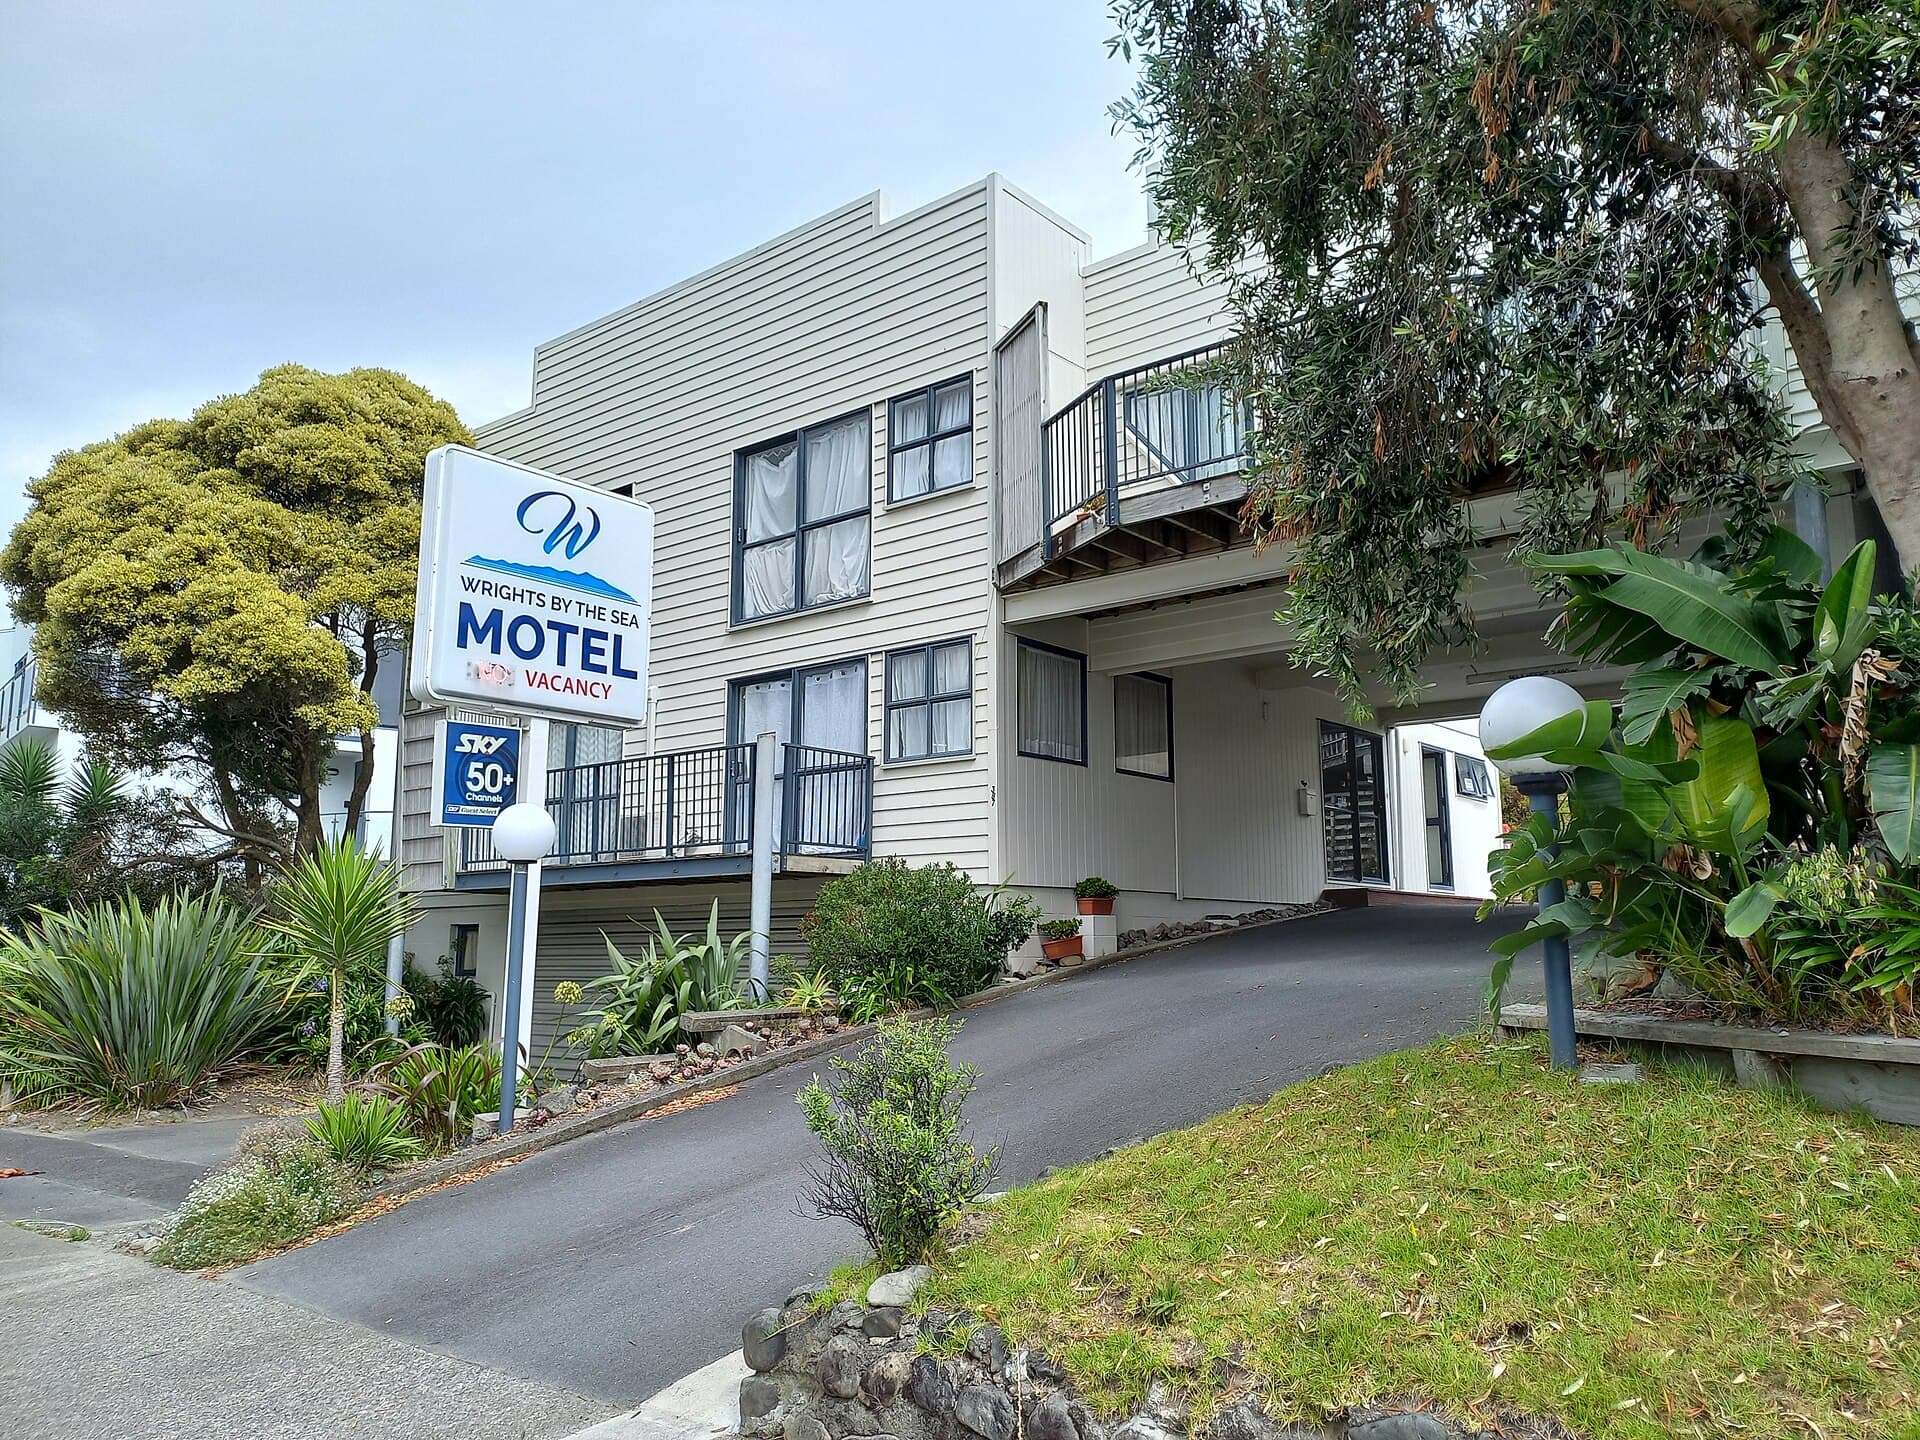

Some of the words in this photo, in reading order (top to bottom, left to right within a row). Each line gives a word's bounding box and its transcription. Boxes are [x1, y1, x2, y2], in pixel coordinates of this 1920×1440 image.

[460, 575, 546, 608] WRIGHTS
[551, 595, 573, 614] BY
[575, 602, 607, 622] THE
[611, 609, 640, 629] SEA
[456, 601, 638, 681] MOTEL
[525, 669, 612, 700] VACANCY
[455, 733, 508, 755] SKY
[465, 761, 514, 794] 50+
[465, 792, 503, 803] Channels
